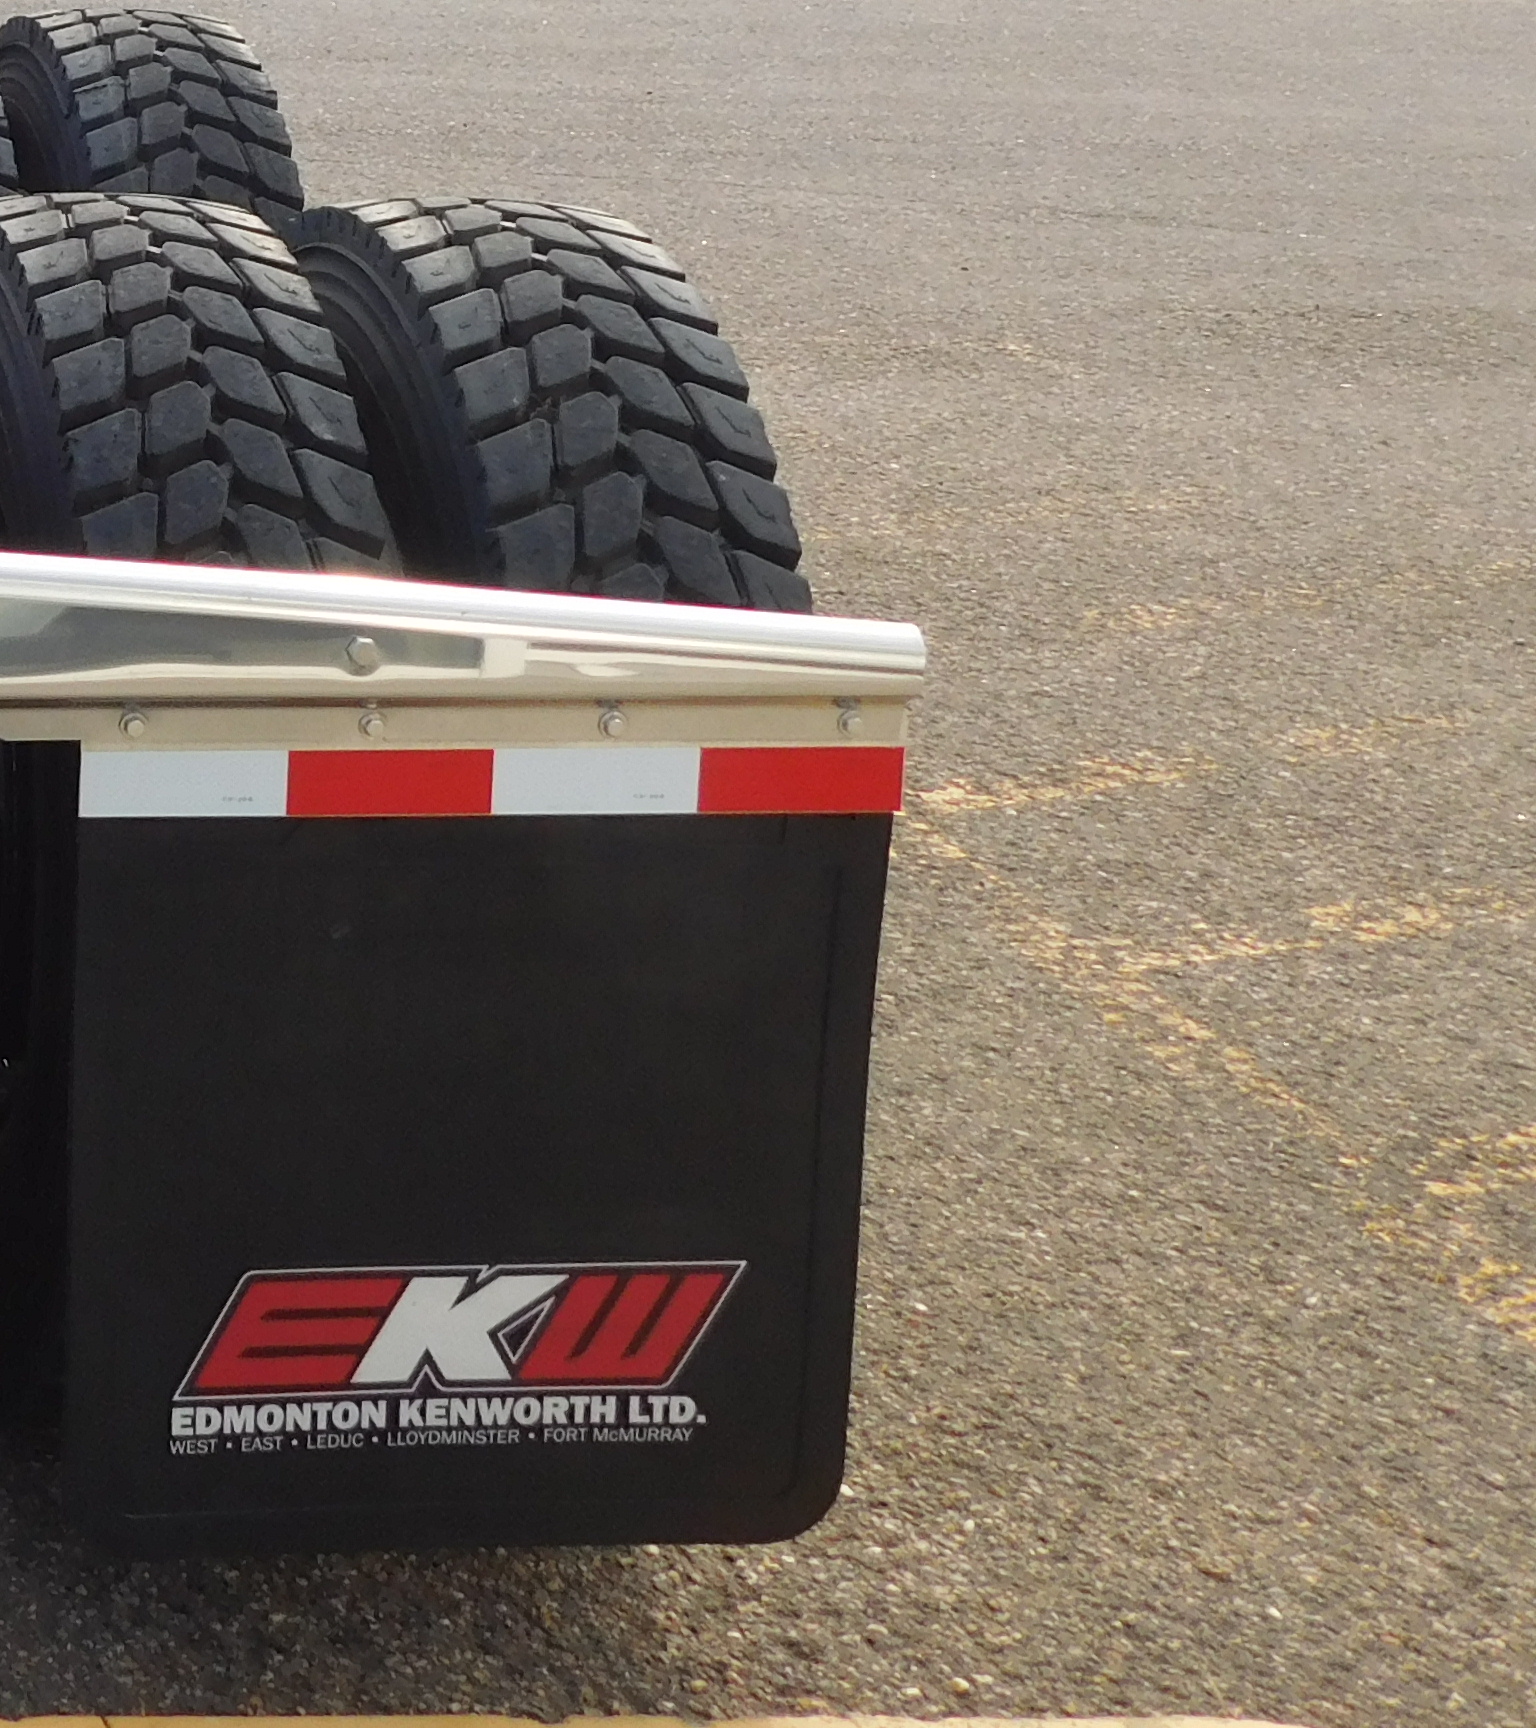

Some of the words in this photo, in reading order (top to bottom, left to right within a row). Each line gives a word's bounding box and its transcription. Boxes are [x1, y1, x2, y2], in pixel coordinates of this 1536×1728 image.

[196, 1274, 725, 1389] EKW
[171, 1400, 387, 1436] EDMONTON
[398, 1395, 617, 1427] KENWORTH
[629, 1394, 707, 1424] LTD.
[169, 1438, 218, 1455] WEST
[241, 1435, 284, 1452] EAST
[306, 1433, 365, 1449] LEDUC
[386, 1429, 520, 1447] LLOYDMINSTER
[544, 1428, 588, 1443] FORT
[593, 1427, 694, 1443] McMURRAY
